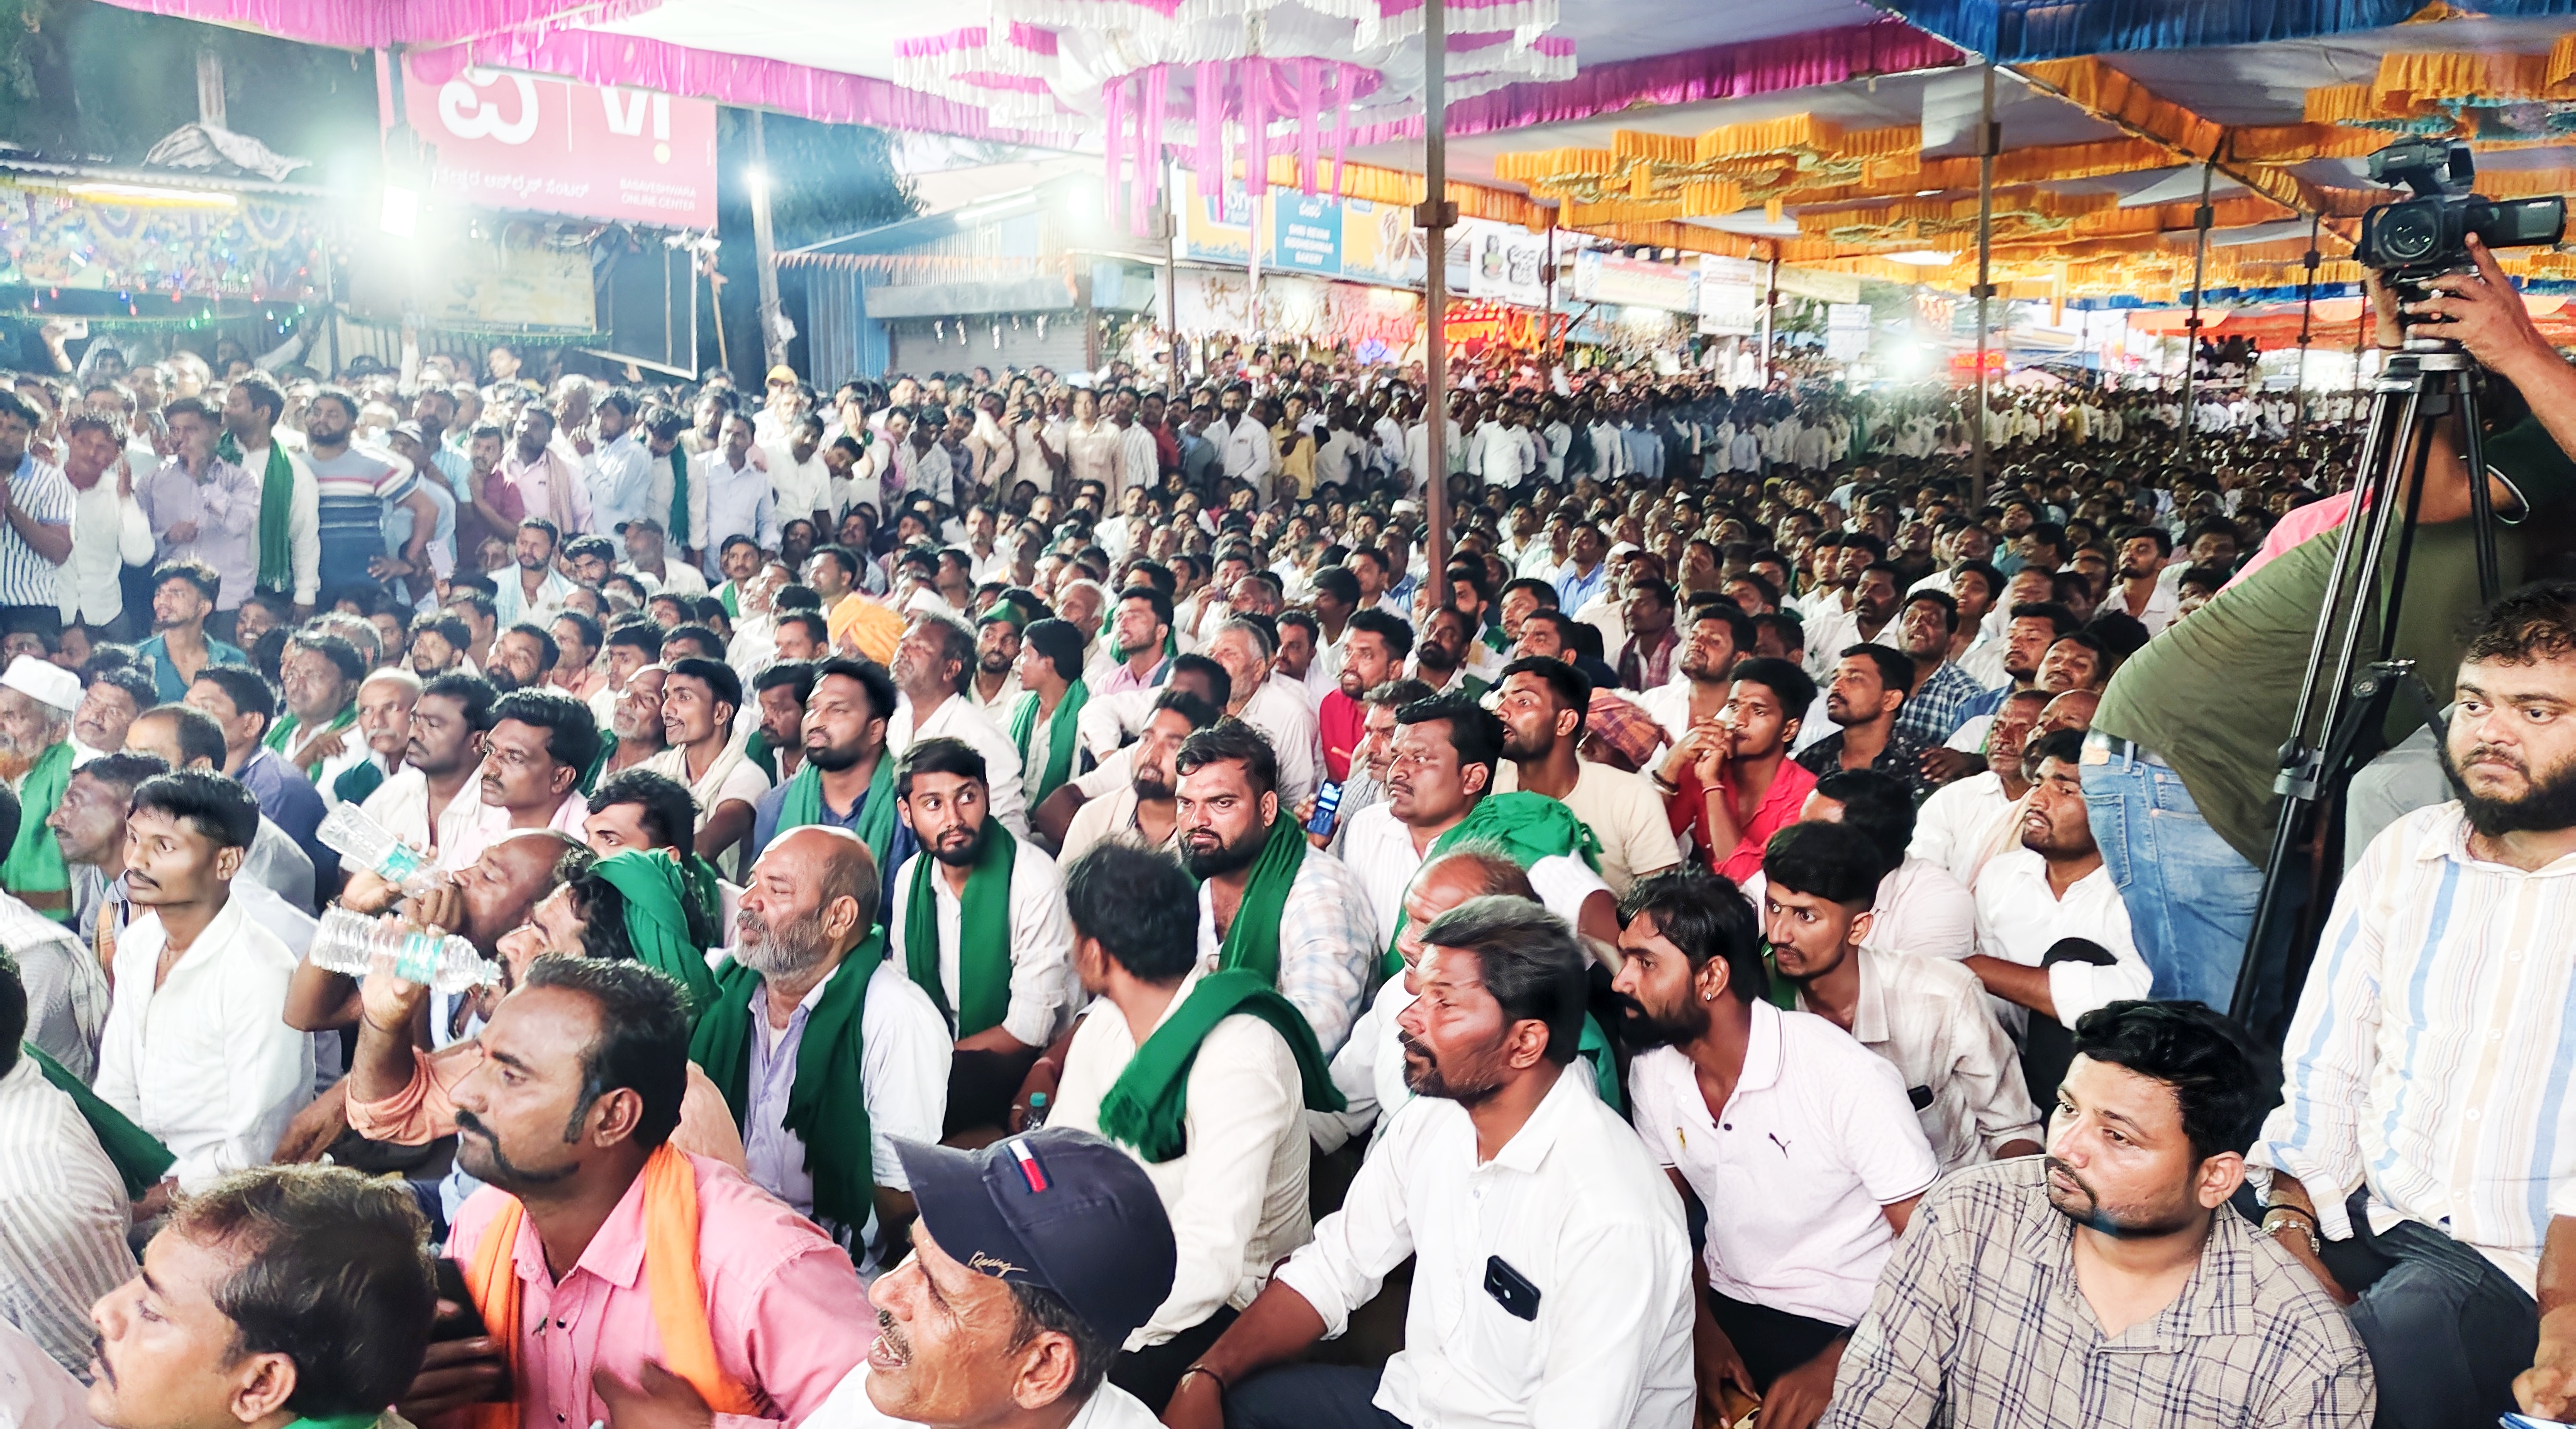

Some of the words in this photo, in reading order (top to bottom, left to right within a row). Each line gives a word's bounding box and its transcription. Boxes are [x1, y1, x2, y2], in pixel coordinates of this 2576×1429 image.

[621, 191, 657, 208] ONLINE
[658, 196, 696, 212] CENTER
[1295, 250, 1324, 266] BAKERY
